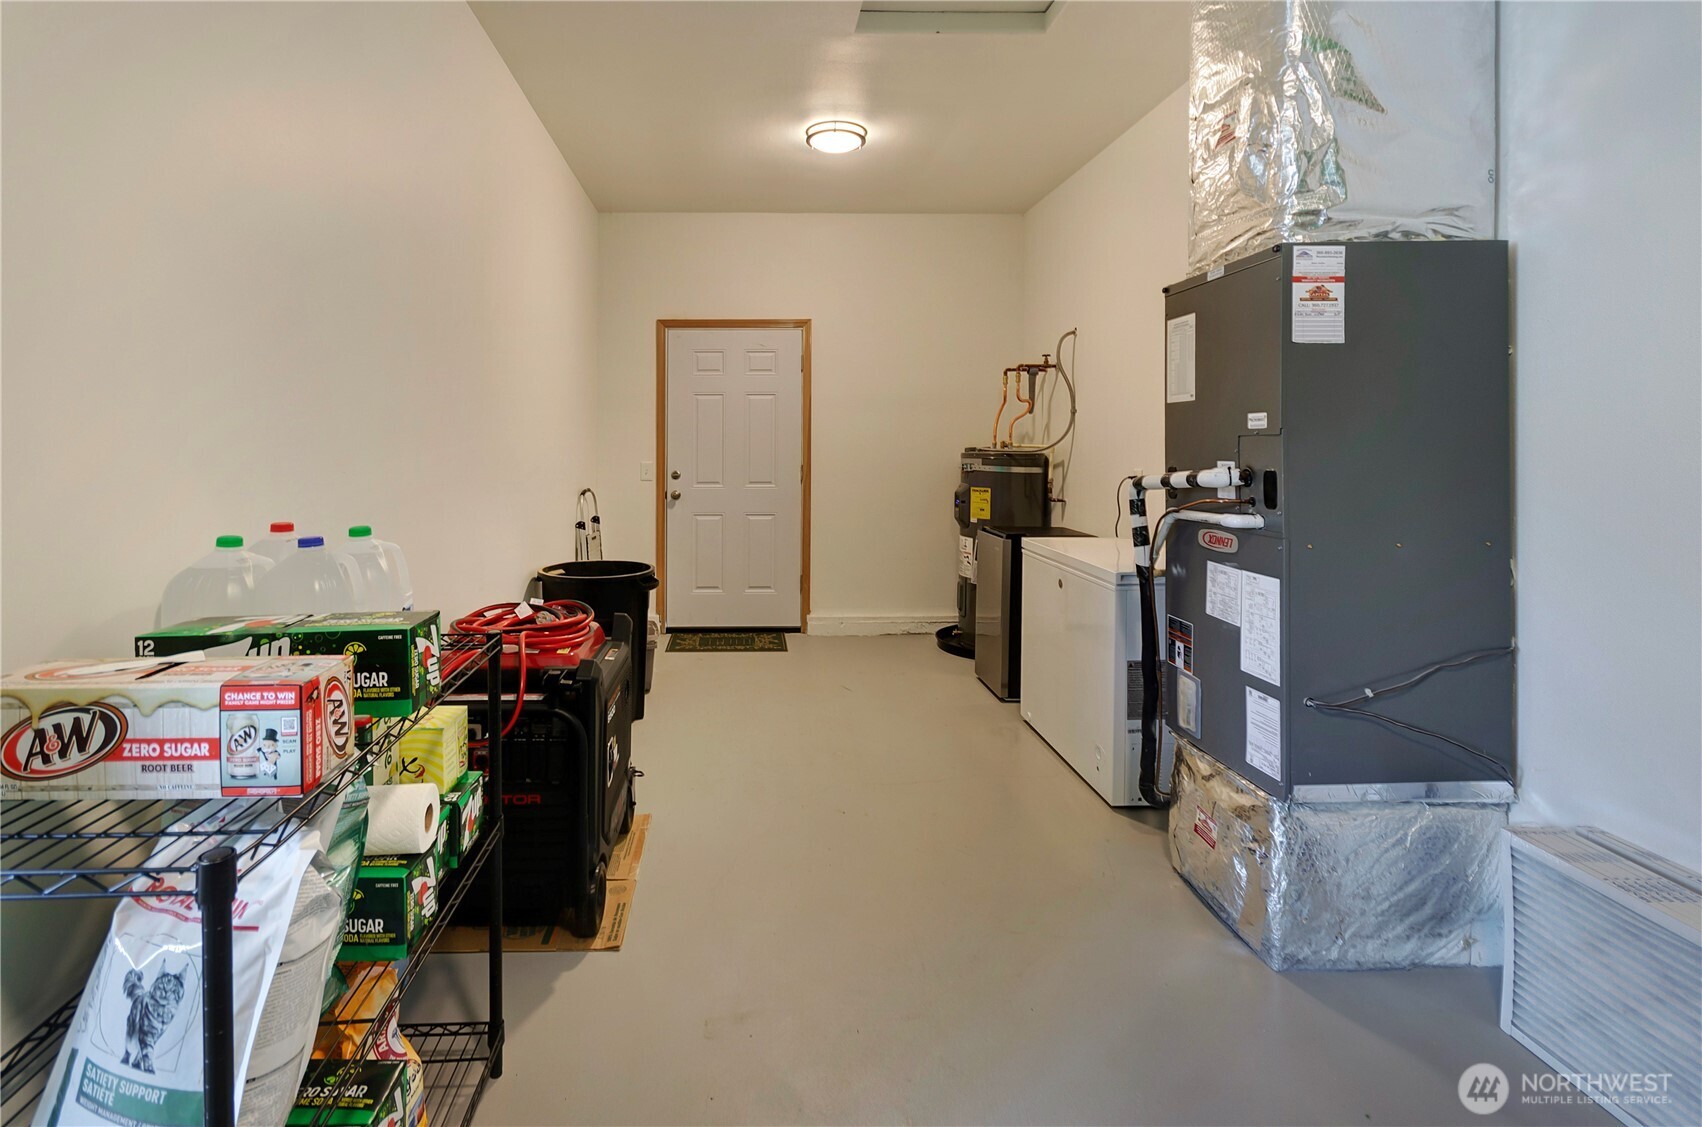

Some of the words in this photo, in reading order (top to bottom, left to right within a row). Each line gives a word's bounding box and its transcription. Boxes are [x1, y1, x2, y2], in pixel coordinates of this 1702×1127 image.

[1208, 534, 1233, 548] LENNOX
[137, 640, 154, 655] 12
[354, 672, 388, 688] UGAR
[224, 692, 260, 701] CHANCE
[262, 692, 276, 700] TO
[277, 691, 295, 700] WIN
[327, 699, 349, 737] A&W
[22, 709, 100, 774] A&W
[122, 743, 160, 757] ZERO
[163, 742, 210, 757] SUGAR
[141, 763, 168, 773] ROOT
[170, 763, 194, 773] BEER
[343, 934, 358, 943] ODA
[85, 1064, 119, 1090] SATIETY
[120, 1080, 168, 1105] SUPPORT
